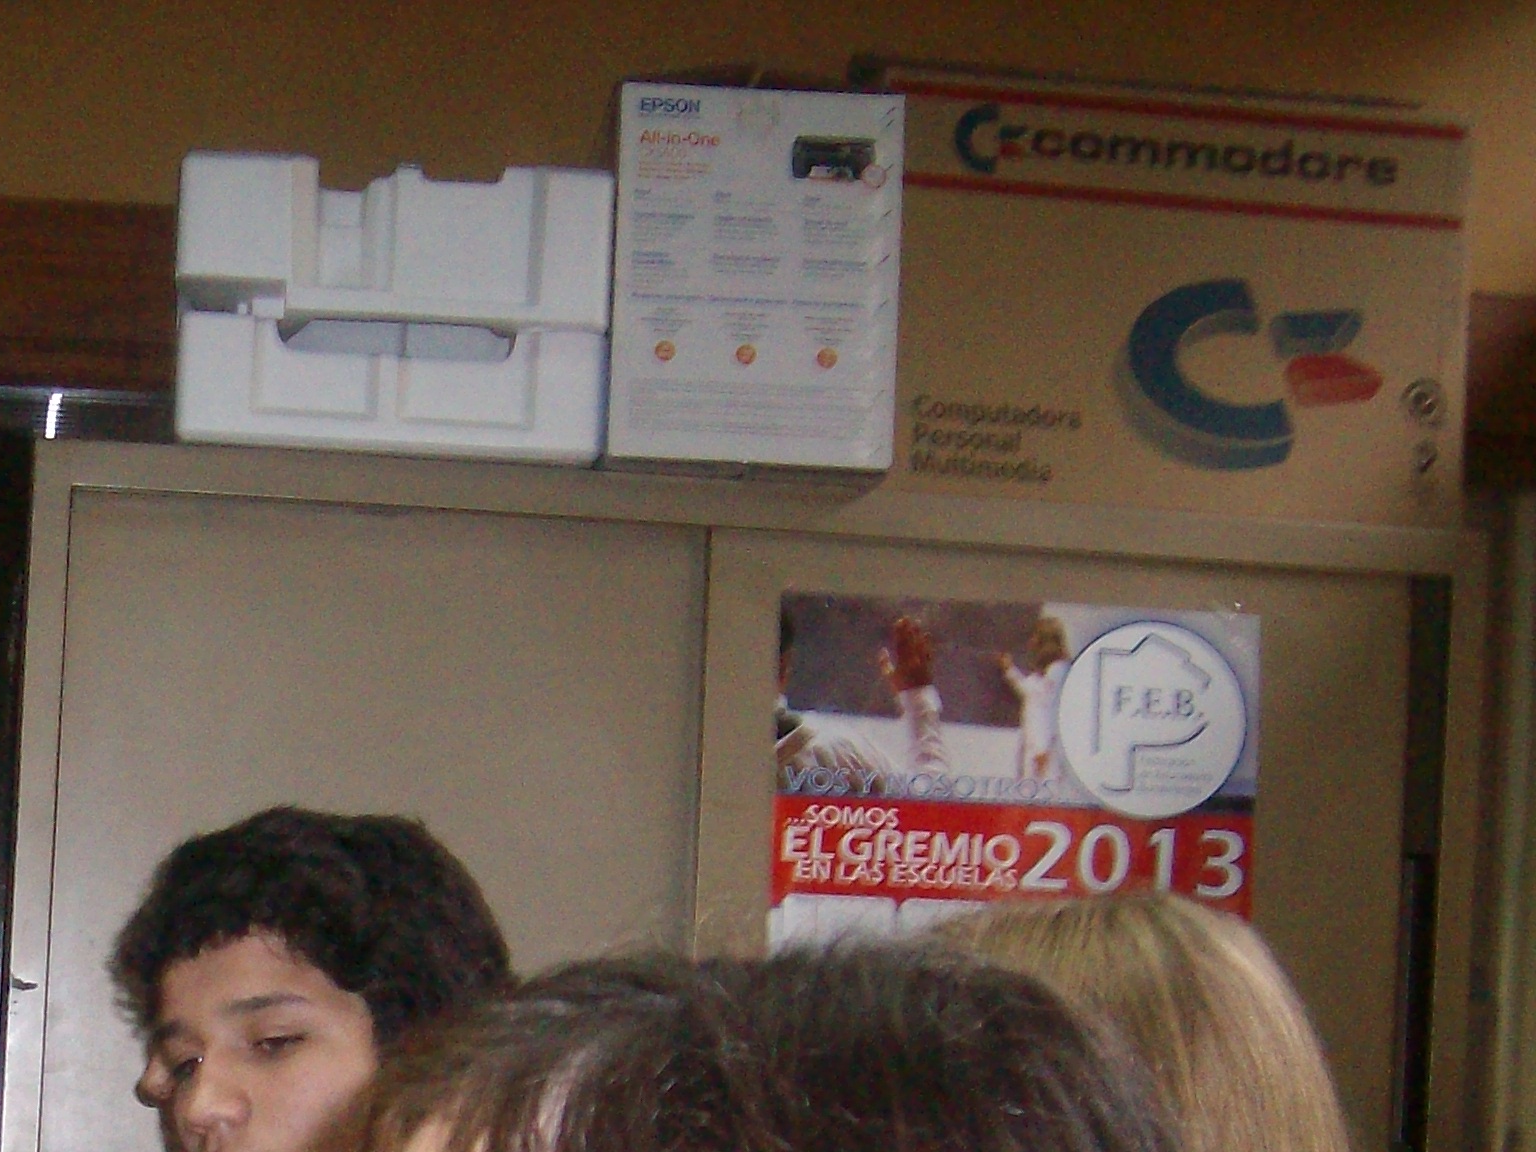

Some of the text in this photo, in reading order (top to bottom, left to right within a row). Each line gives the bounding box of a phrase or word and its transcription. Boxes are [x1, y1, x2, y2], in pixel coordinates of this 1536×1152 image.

[639, 97, 701, 113] EPSON
[1030, 126, 1400, 186] commodore
[785, 766, 851, 794] VOS
[859, 770, 879, 795] Y
[782, 820, 1248, 898] EL GREMIO 2013
[792, 859, 1020, 891] EN LAS ESCUELAS
